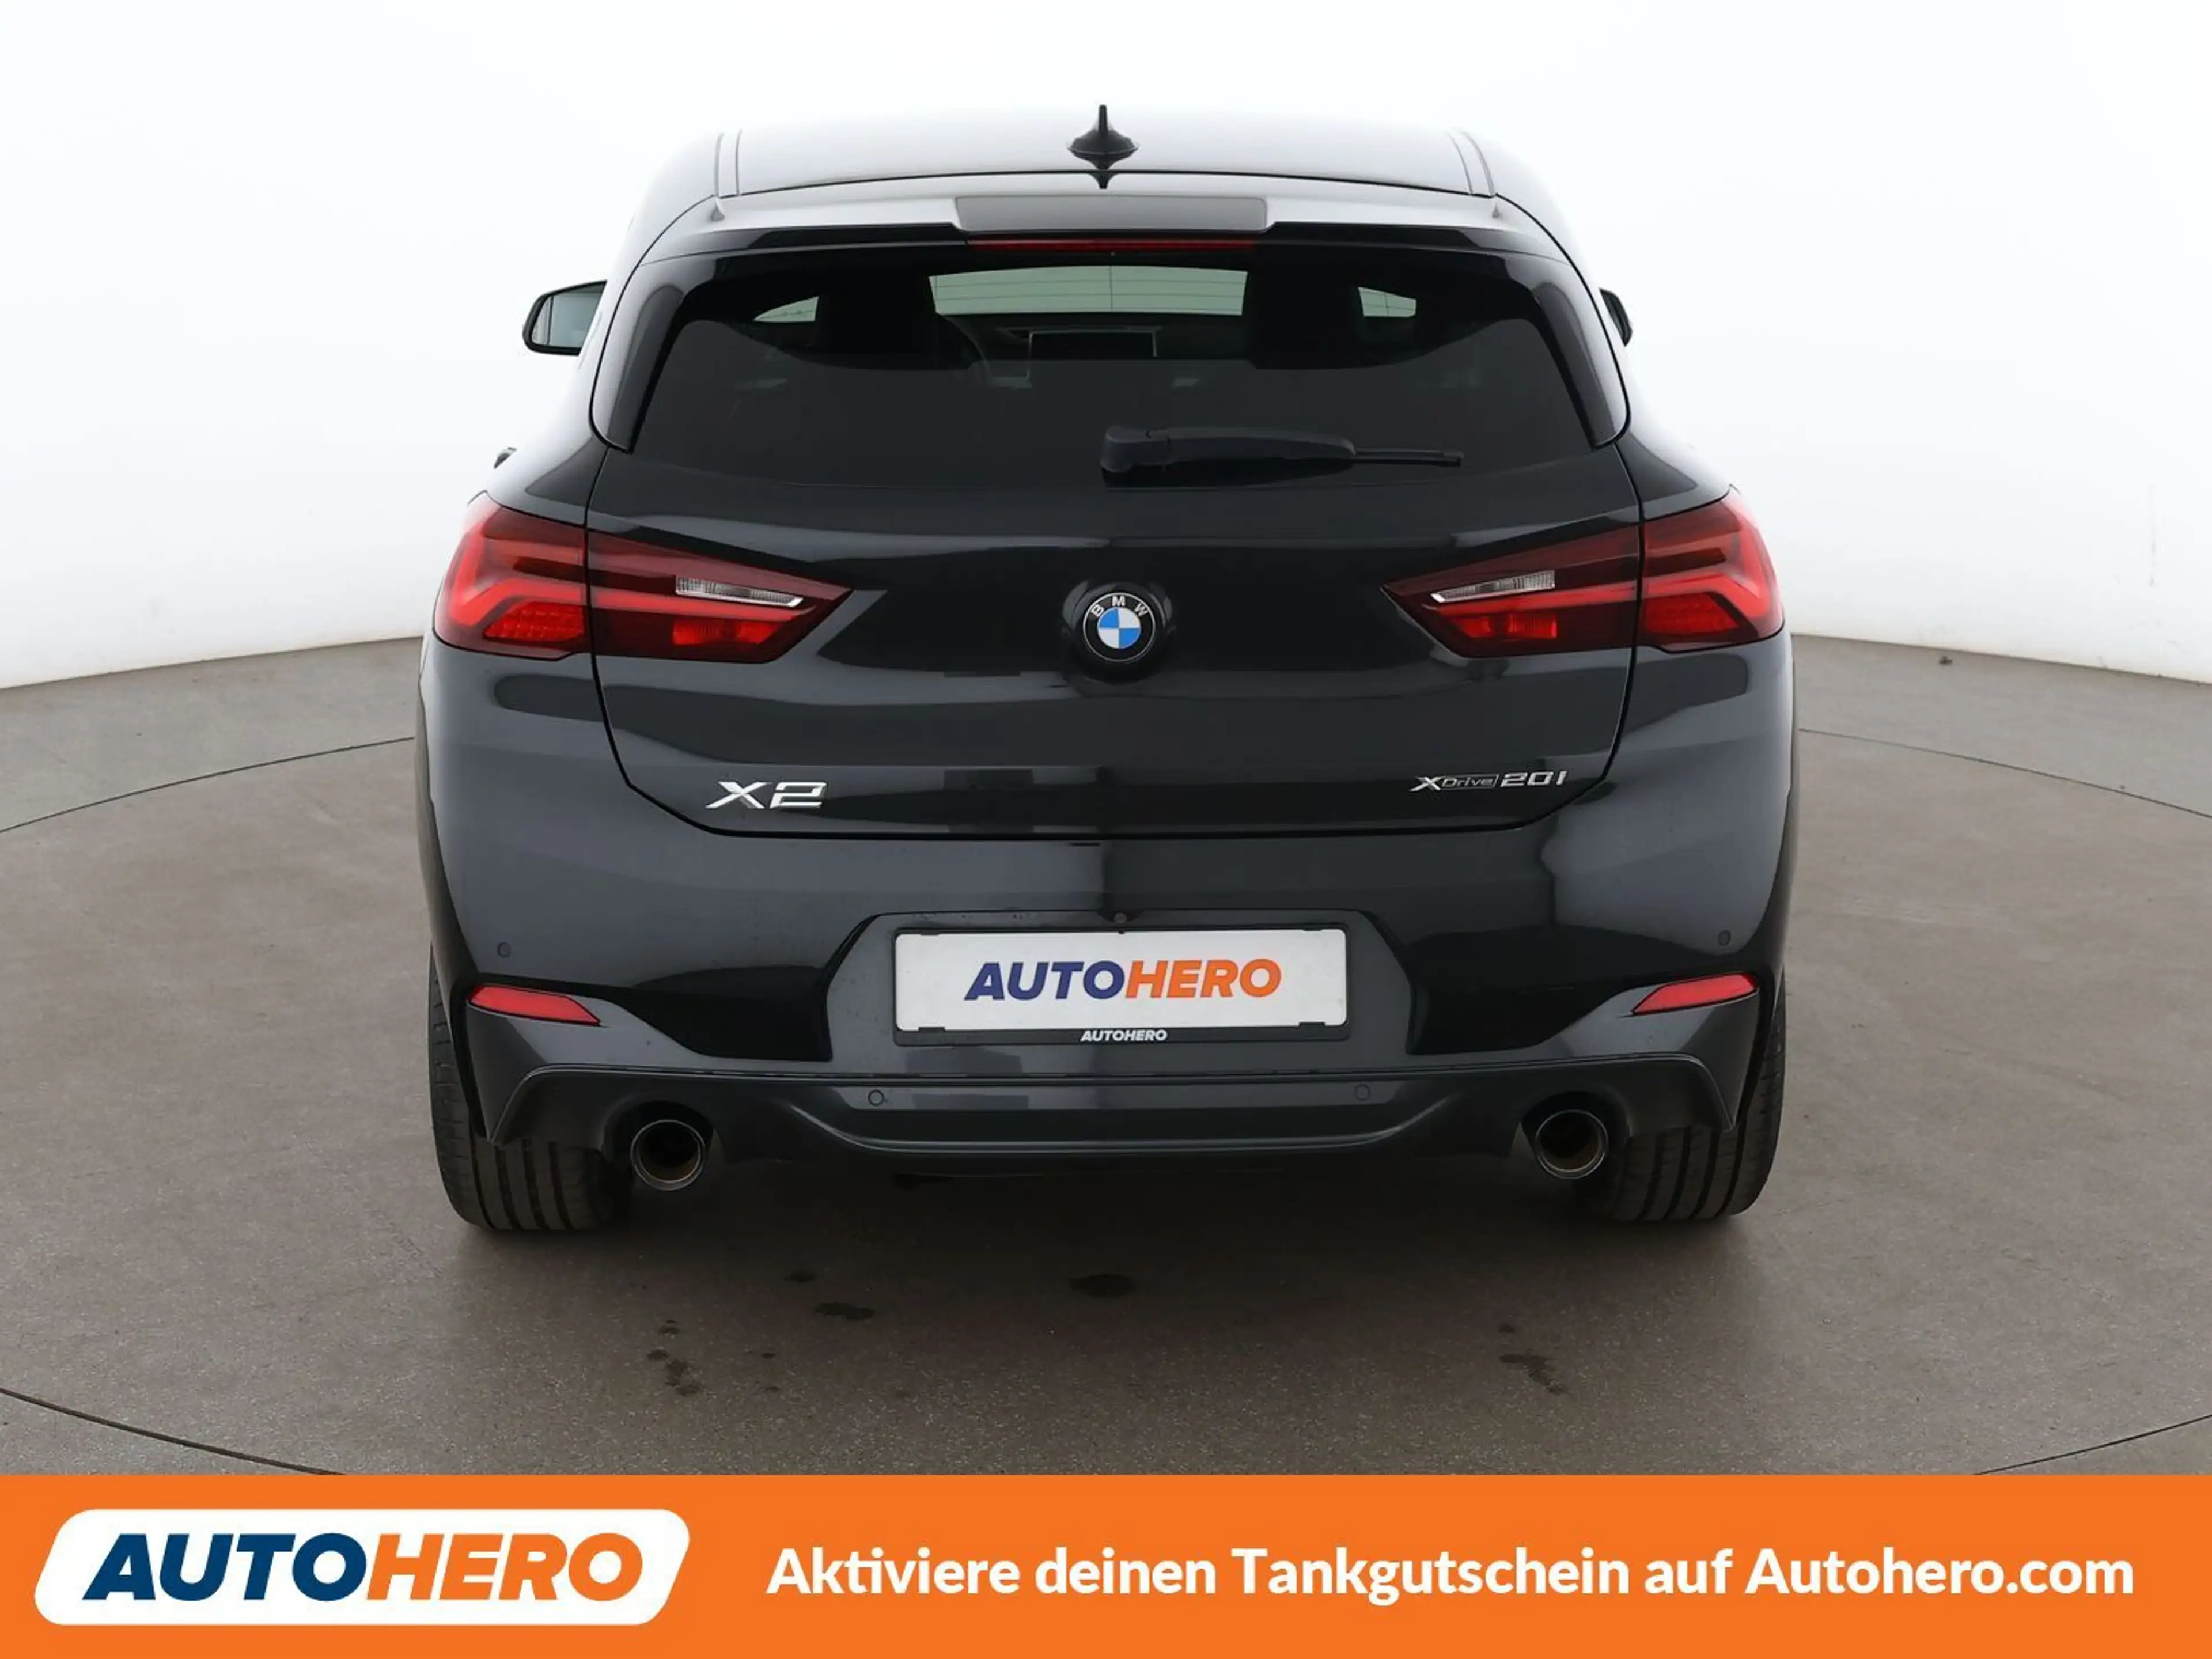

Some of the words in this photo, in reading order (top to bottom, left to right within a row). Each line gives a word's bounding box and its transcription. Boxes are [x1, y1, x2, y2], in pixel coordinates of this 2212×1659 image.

[1090, 596, 1149, 618] BMW
[705, 781, 827, 809] X2
[964, 958, 1282, 1001] AUTOHERO
[1080, 1029, 1168, 1042] AUTOHERO
